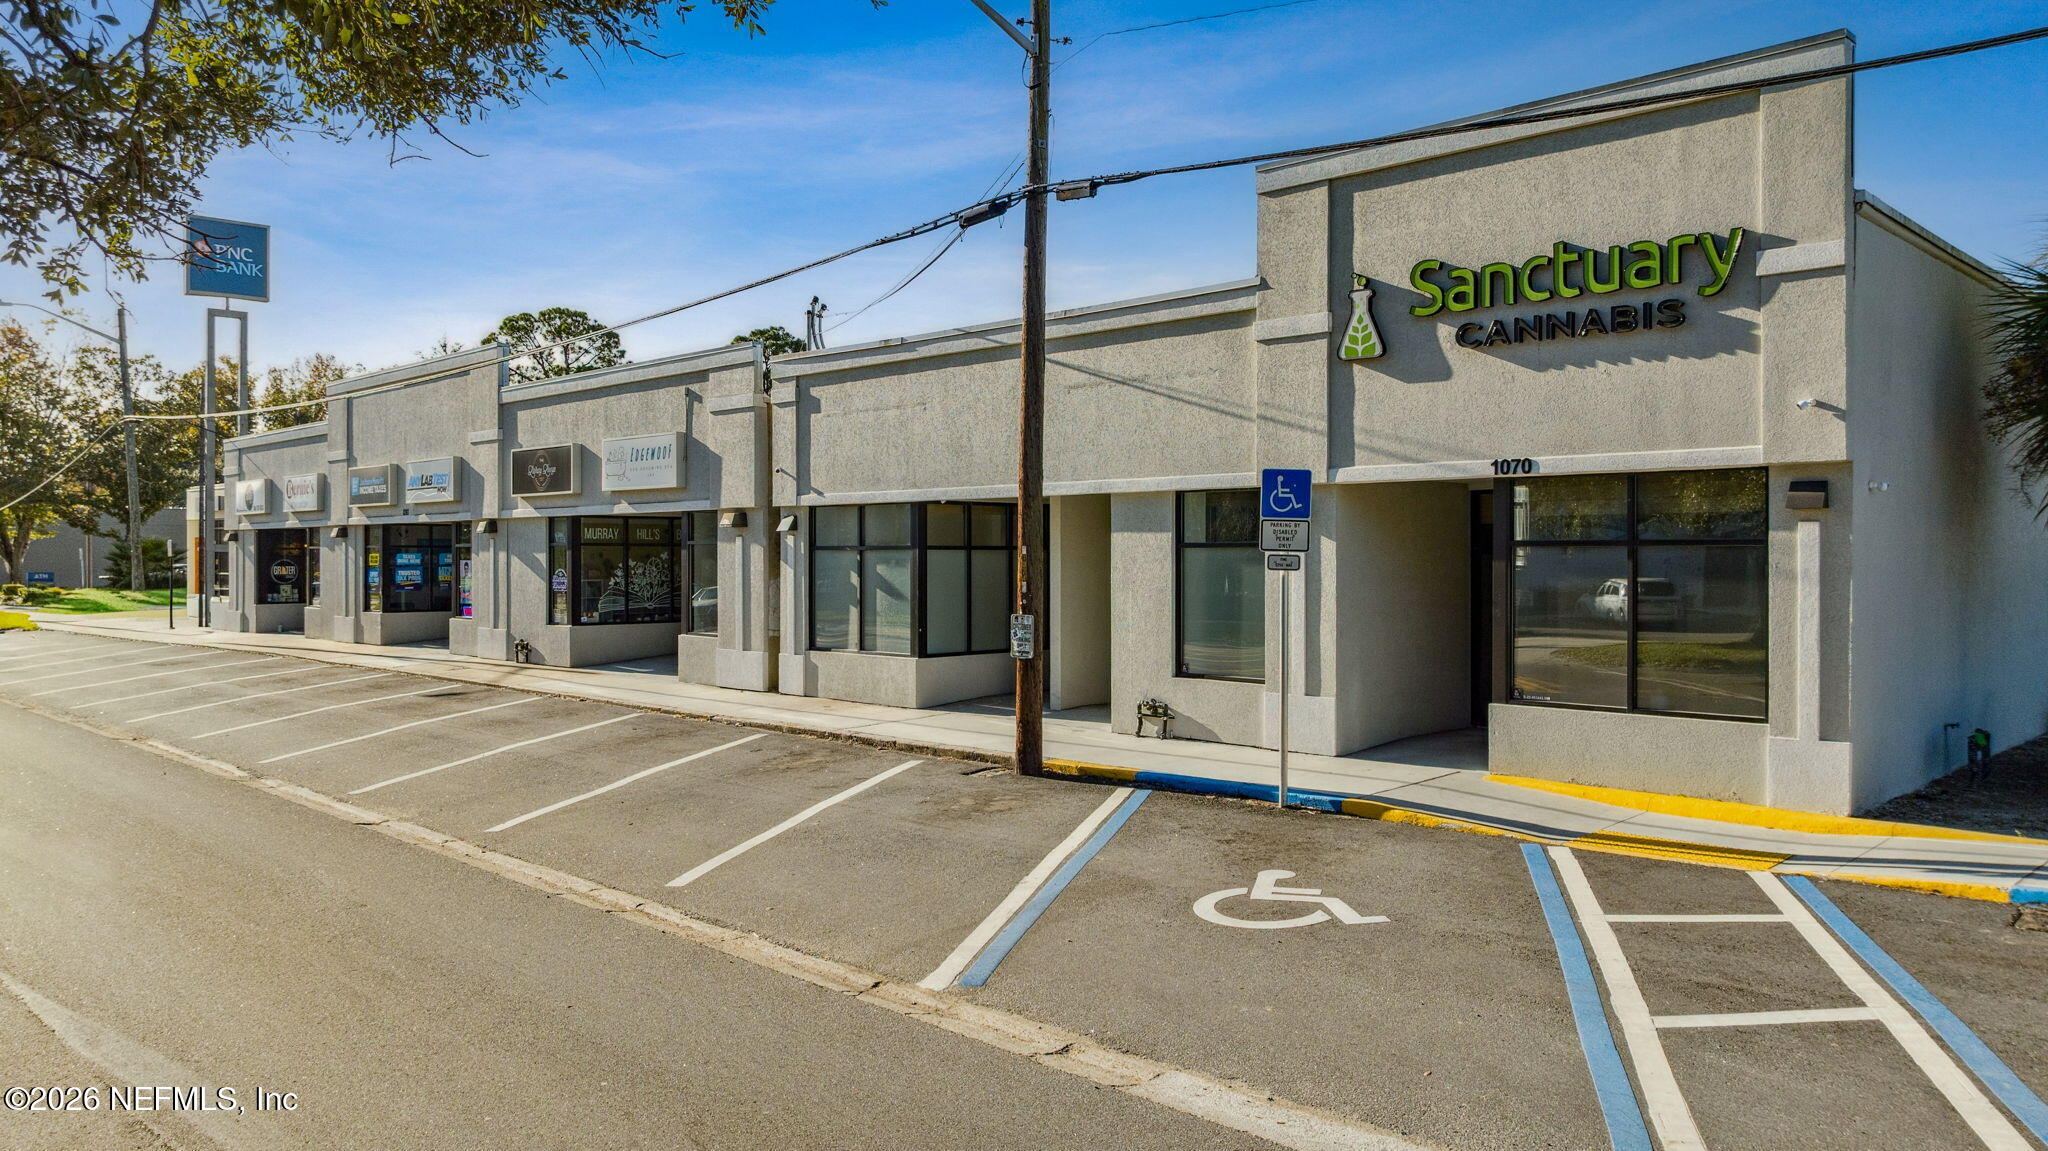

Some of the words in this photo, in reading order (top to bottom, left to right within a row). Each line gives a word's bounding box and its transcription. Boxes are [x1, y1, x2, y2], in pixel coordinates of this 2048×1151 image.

[213, 244, 254, 262] PNC
[216, 261, 263, 278] BANK
[1409, 226, 1746, 318] Sanctuary
[1455, 298, 1687, 349] CANNABIS
[630, 444, 672, 463] EDGEWOOF
[1491, 458, 1532, 476] 1070
[584, 527, 619, 540] MURRAY
[636, 528, 661, 541] HILL'S
